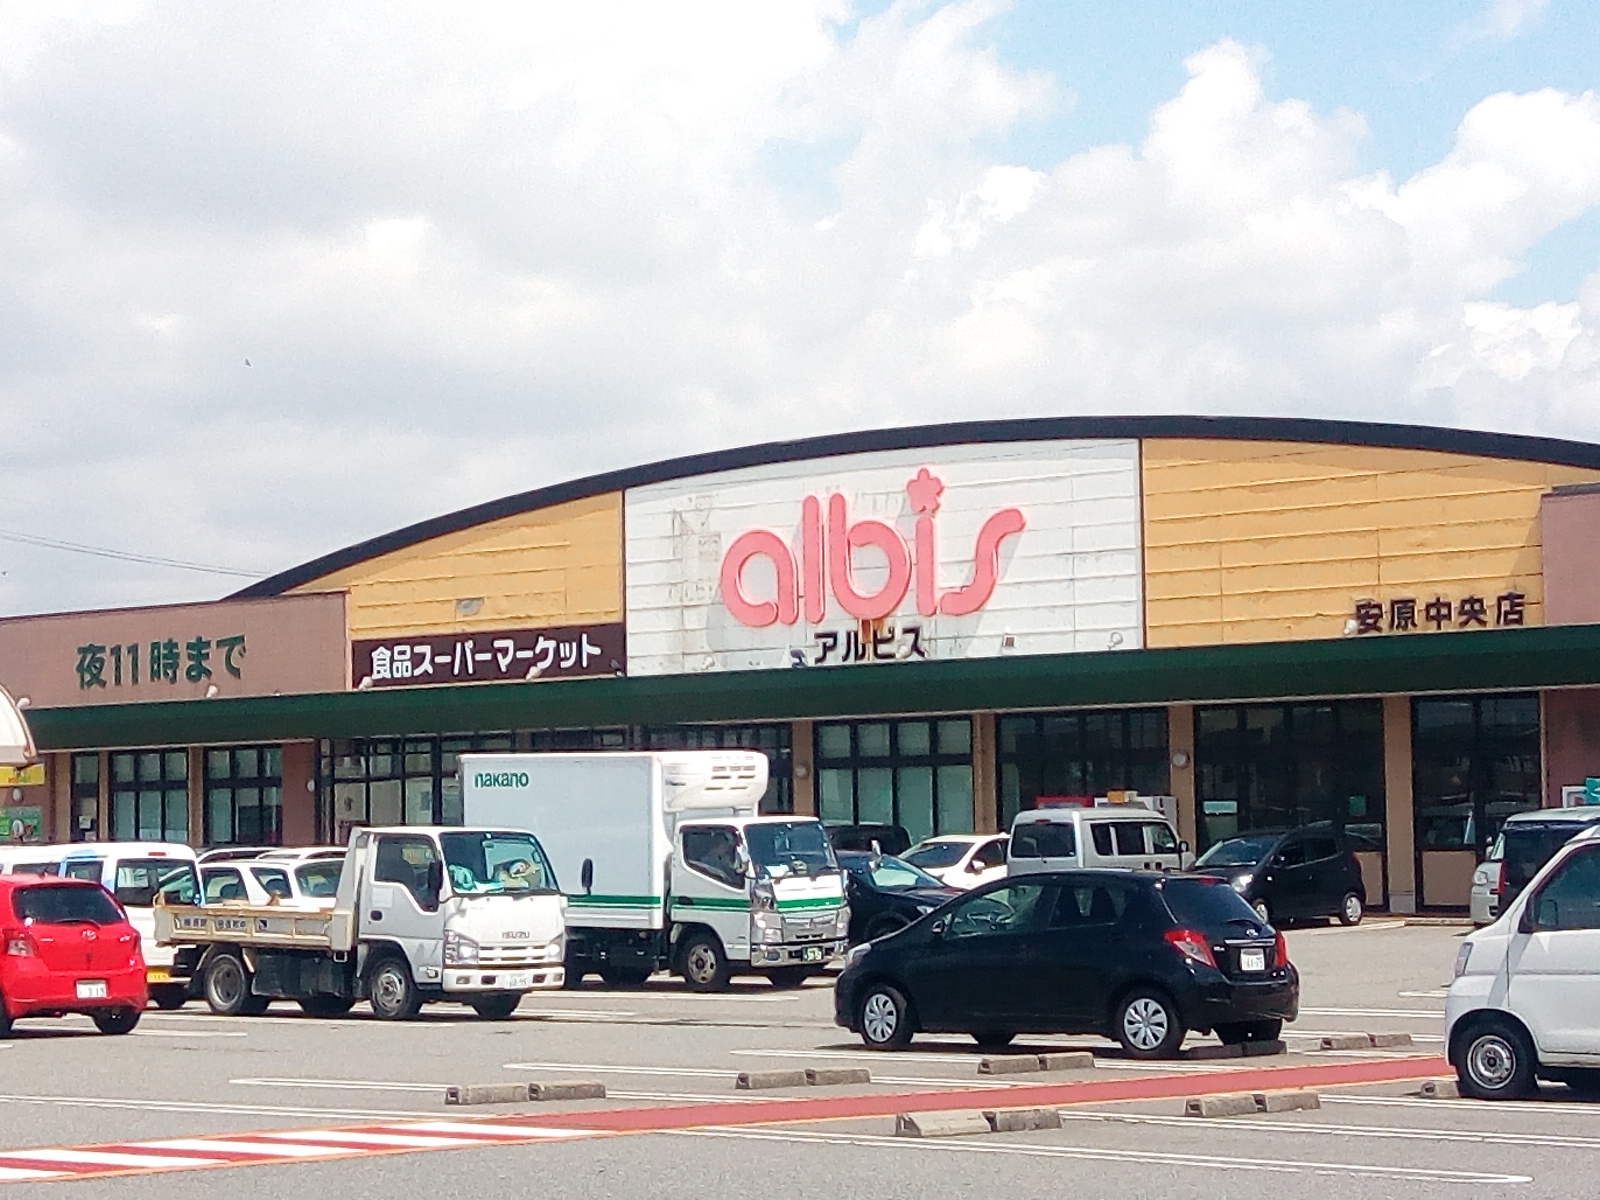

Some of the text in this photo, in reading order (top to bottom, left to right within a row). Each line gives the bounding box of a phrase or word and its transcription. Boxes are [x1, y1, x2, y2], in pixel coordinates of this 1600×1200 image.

[720, 467, 1026, 628] albis
[1355, 591, 1525, 634] 安原中央店
[75, 634, 248, 691] 夜11時まで
[371, 633, 602, 680] 食品スーパーマーケット
[474, 772, 530, 788] nakano
[502, 931, 530, 939] ISUZU
